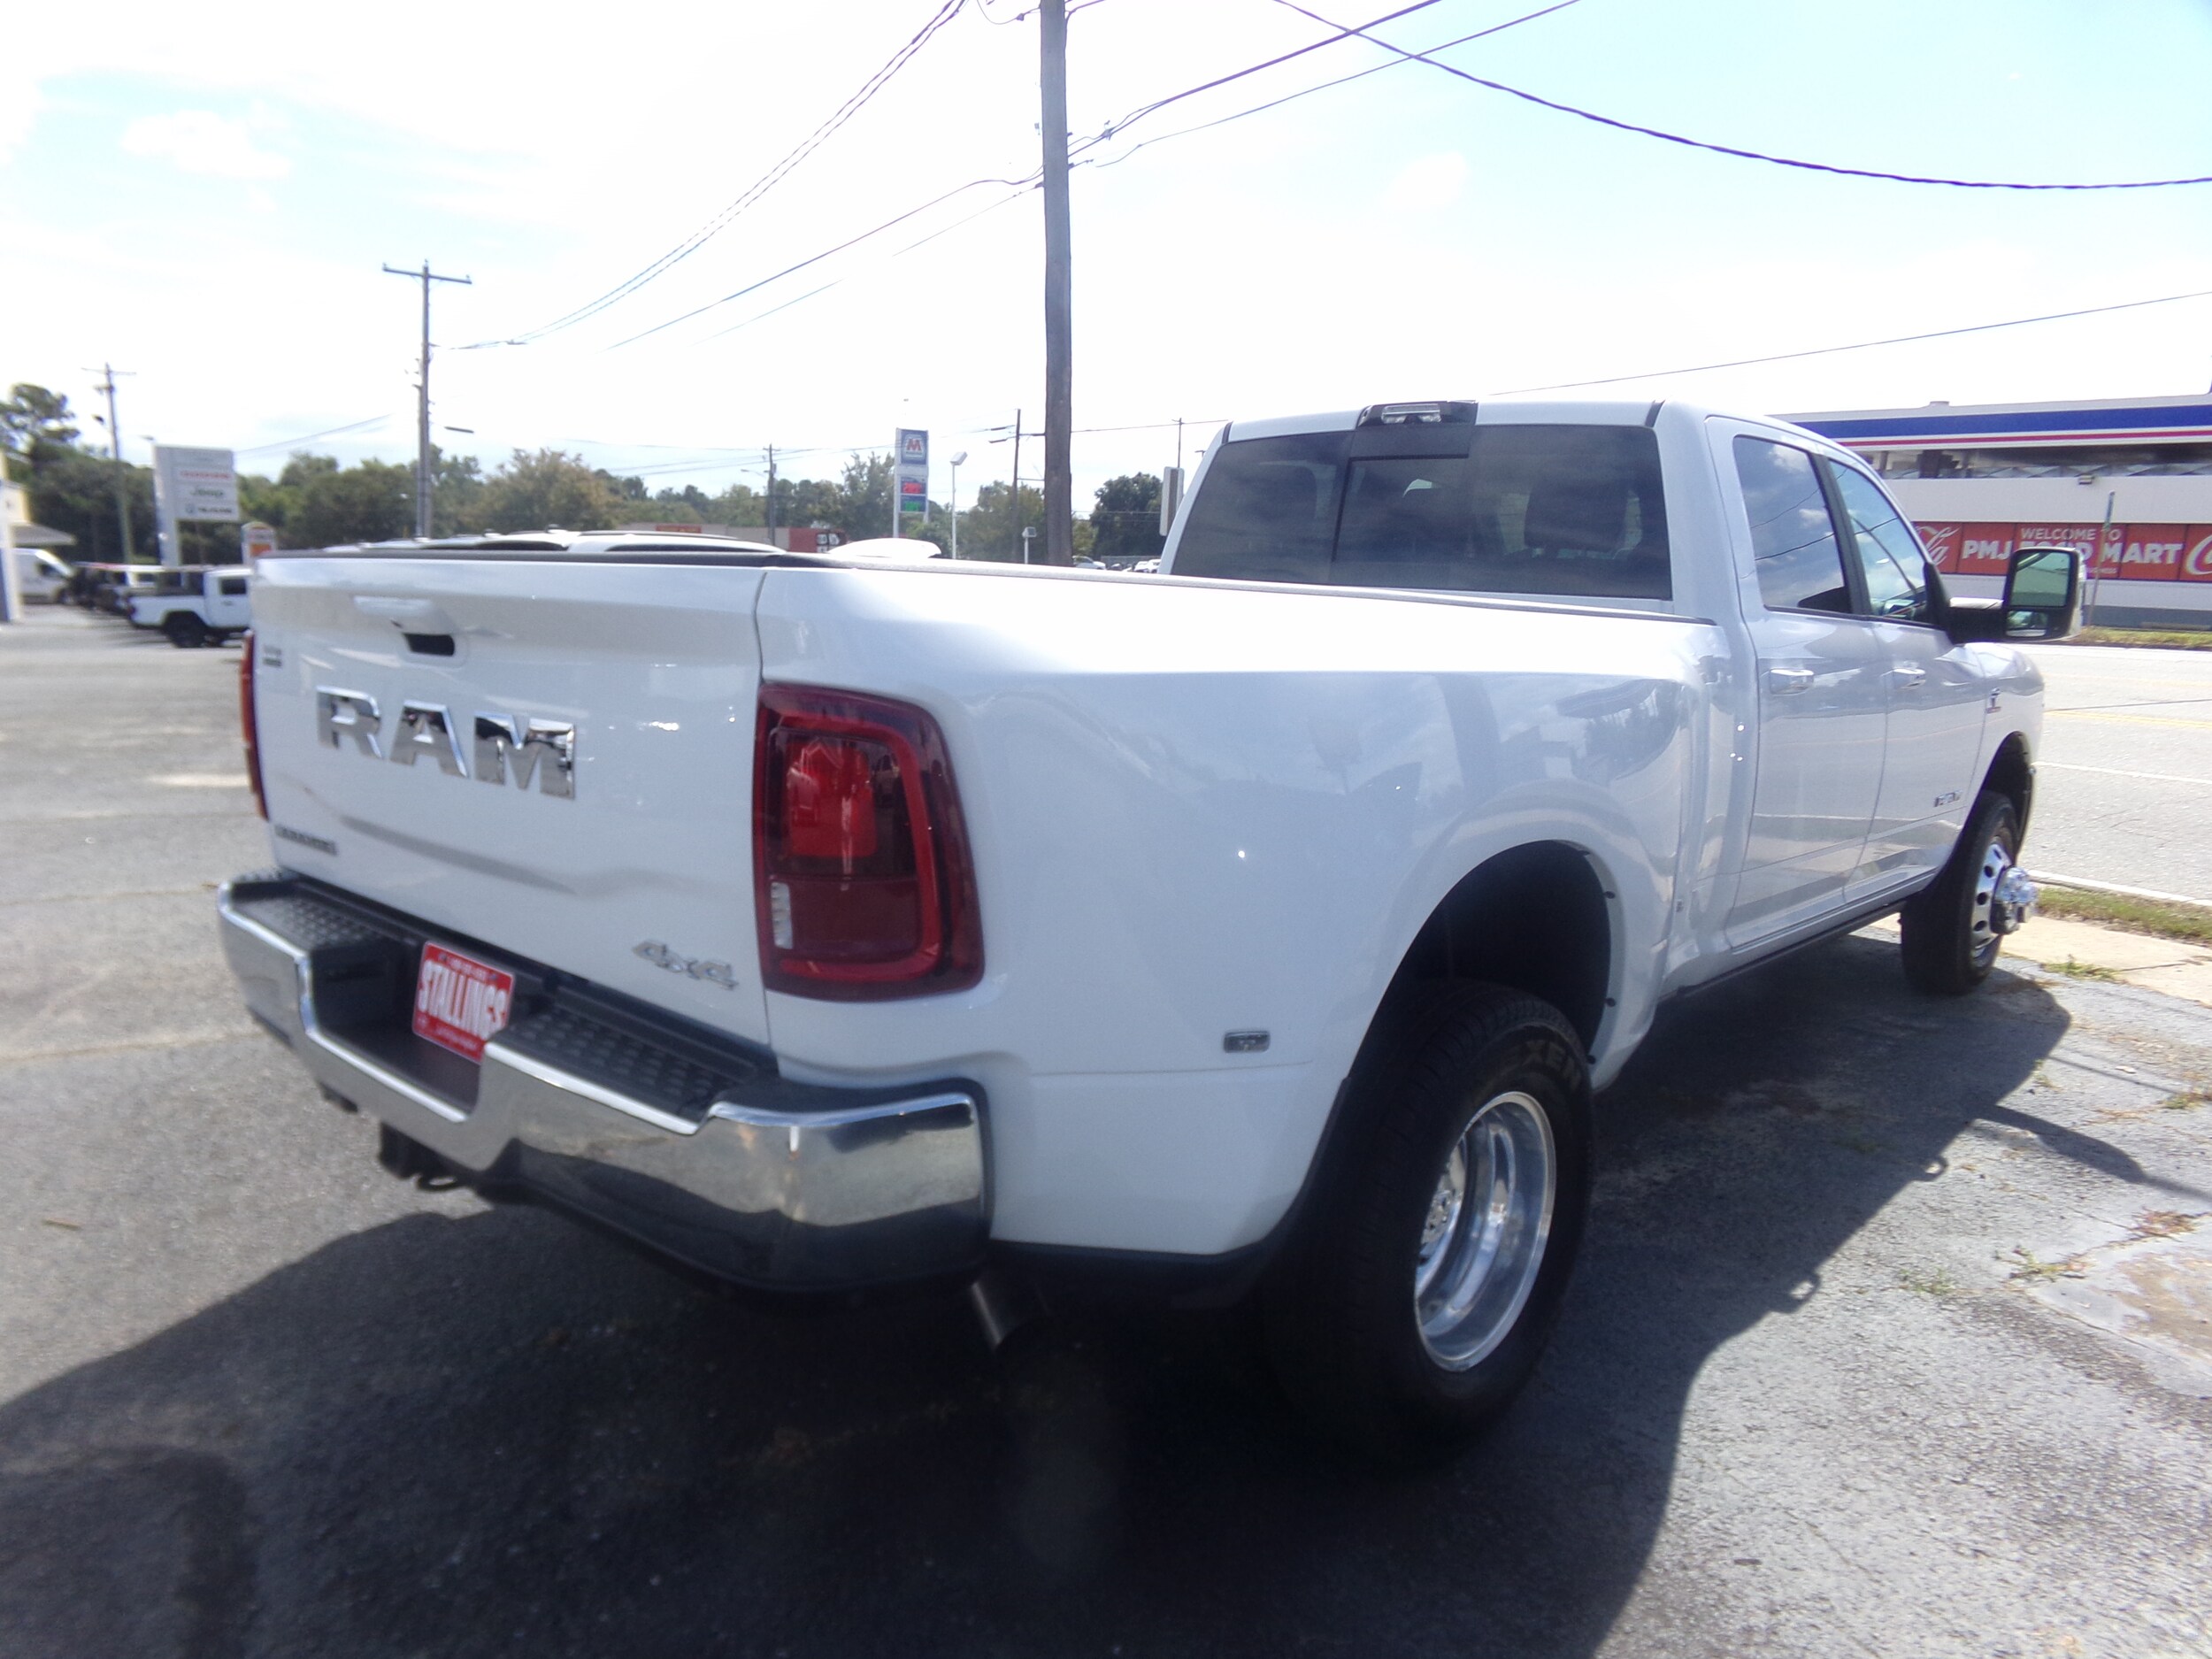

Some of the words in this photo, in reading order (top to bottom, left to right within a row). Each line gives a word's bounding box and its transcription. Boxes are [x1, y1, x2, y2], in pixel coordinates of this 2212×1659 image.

[1962, 540, 2013, 560] PMJ
[2101, 541, 2184, 564] MART
[2021, 527, 2096, 541] WELCOME
[316, 685, 575, 800] RAM
[419, 960, 507, 1041] STALLINGS
